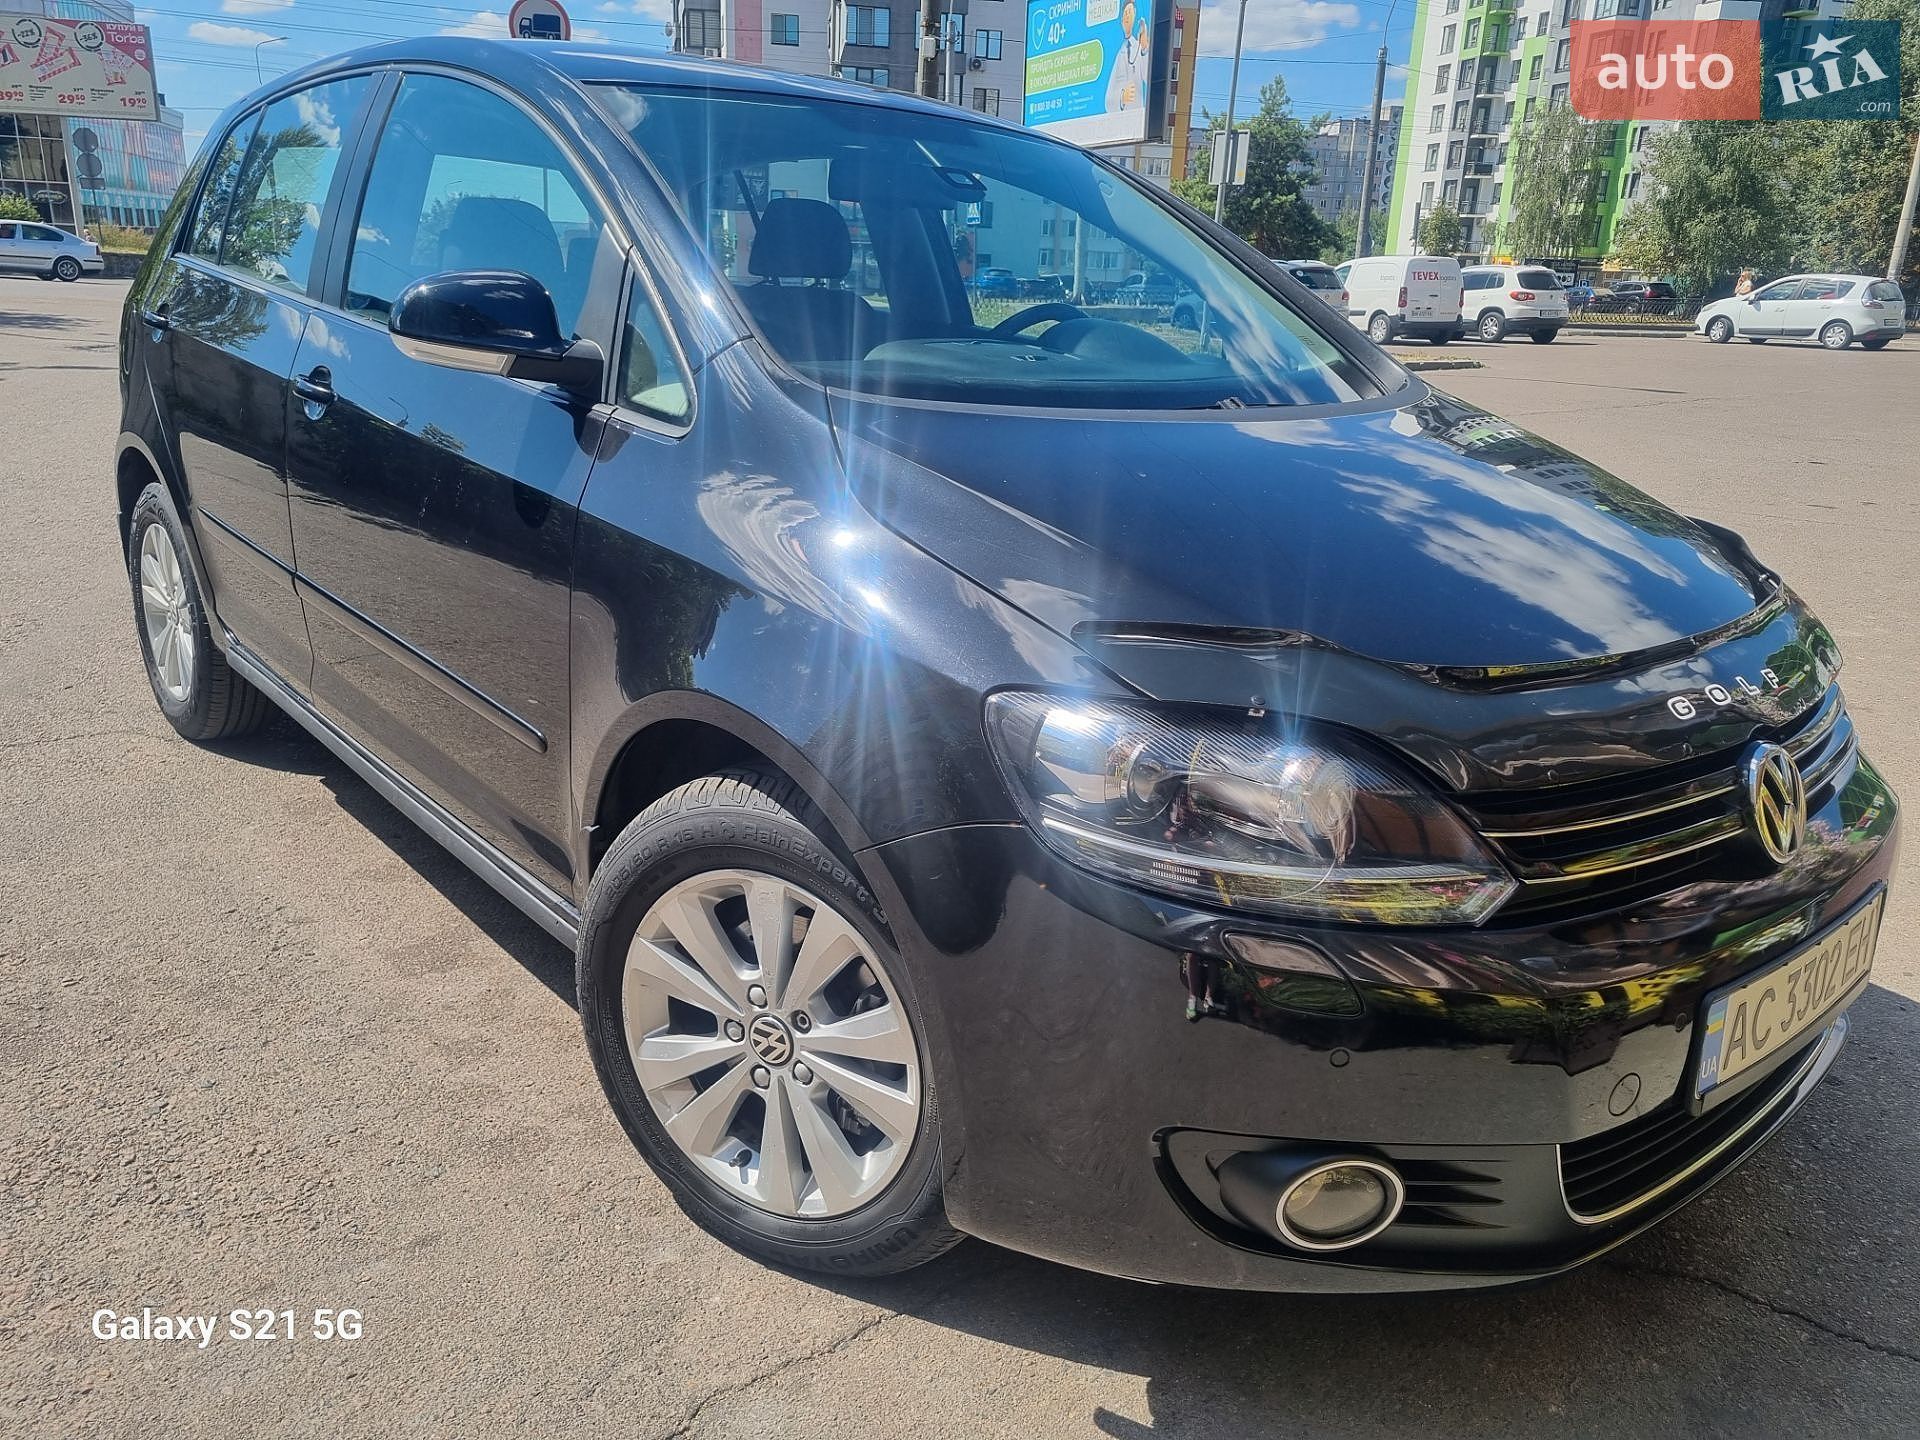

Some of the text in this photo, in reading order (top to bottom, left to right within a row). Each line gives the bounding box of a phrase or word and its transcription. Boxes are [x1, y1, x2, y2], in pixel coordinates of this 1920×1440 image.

[1047, 22, 1066, 45] 40+
[1412, 271, 1439, 281] TEVEX
[1667, 668, 1780, 720] GOLF
[1723, 987, 1776, 1071] AC
[1781, 940, 1843, 1033] 3302
[1701, 1055, 1718, 1078] UA
